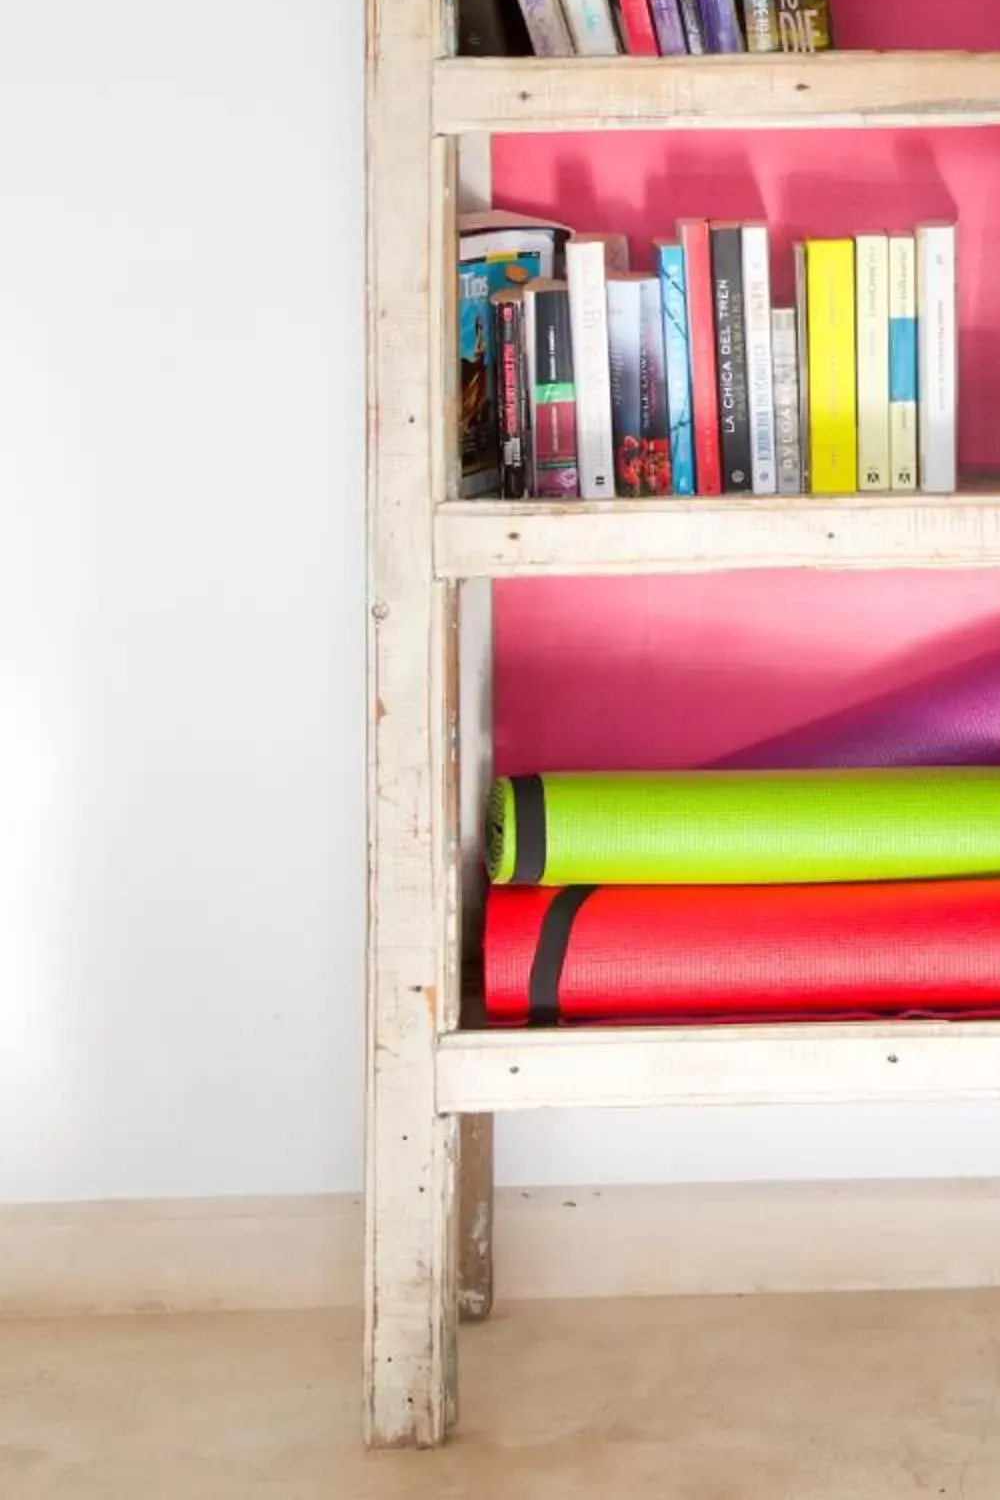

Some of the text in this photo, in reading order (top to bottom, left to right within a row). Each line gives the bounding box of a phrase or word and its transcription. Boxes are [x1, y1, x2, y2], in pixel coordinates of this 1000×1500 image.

[717, 278, 735, 432] LA CHICA DEL TREN
